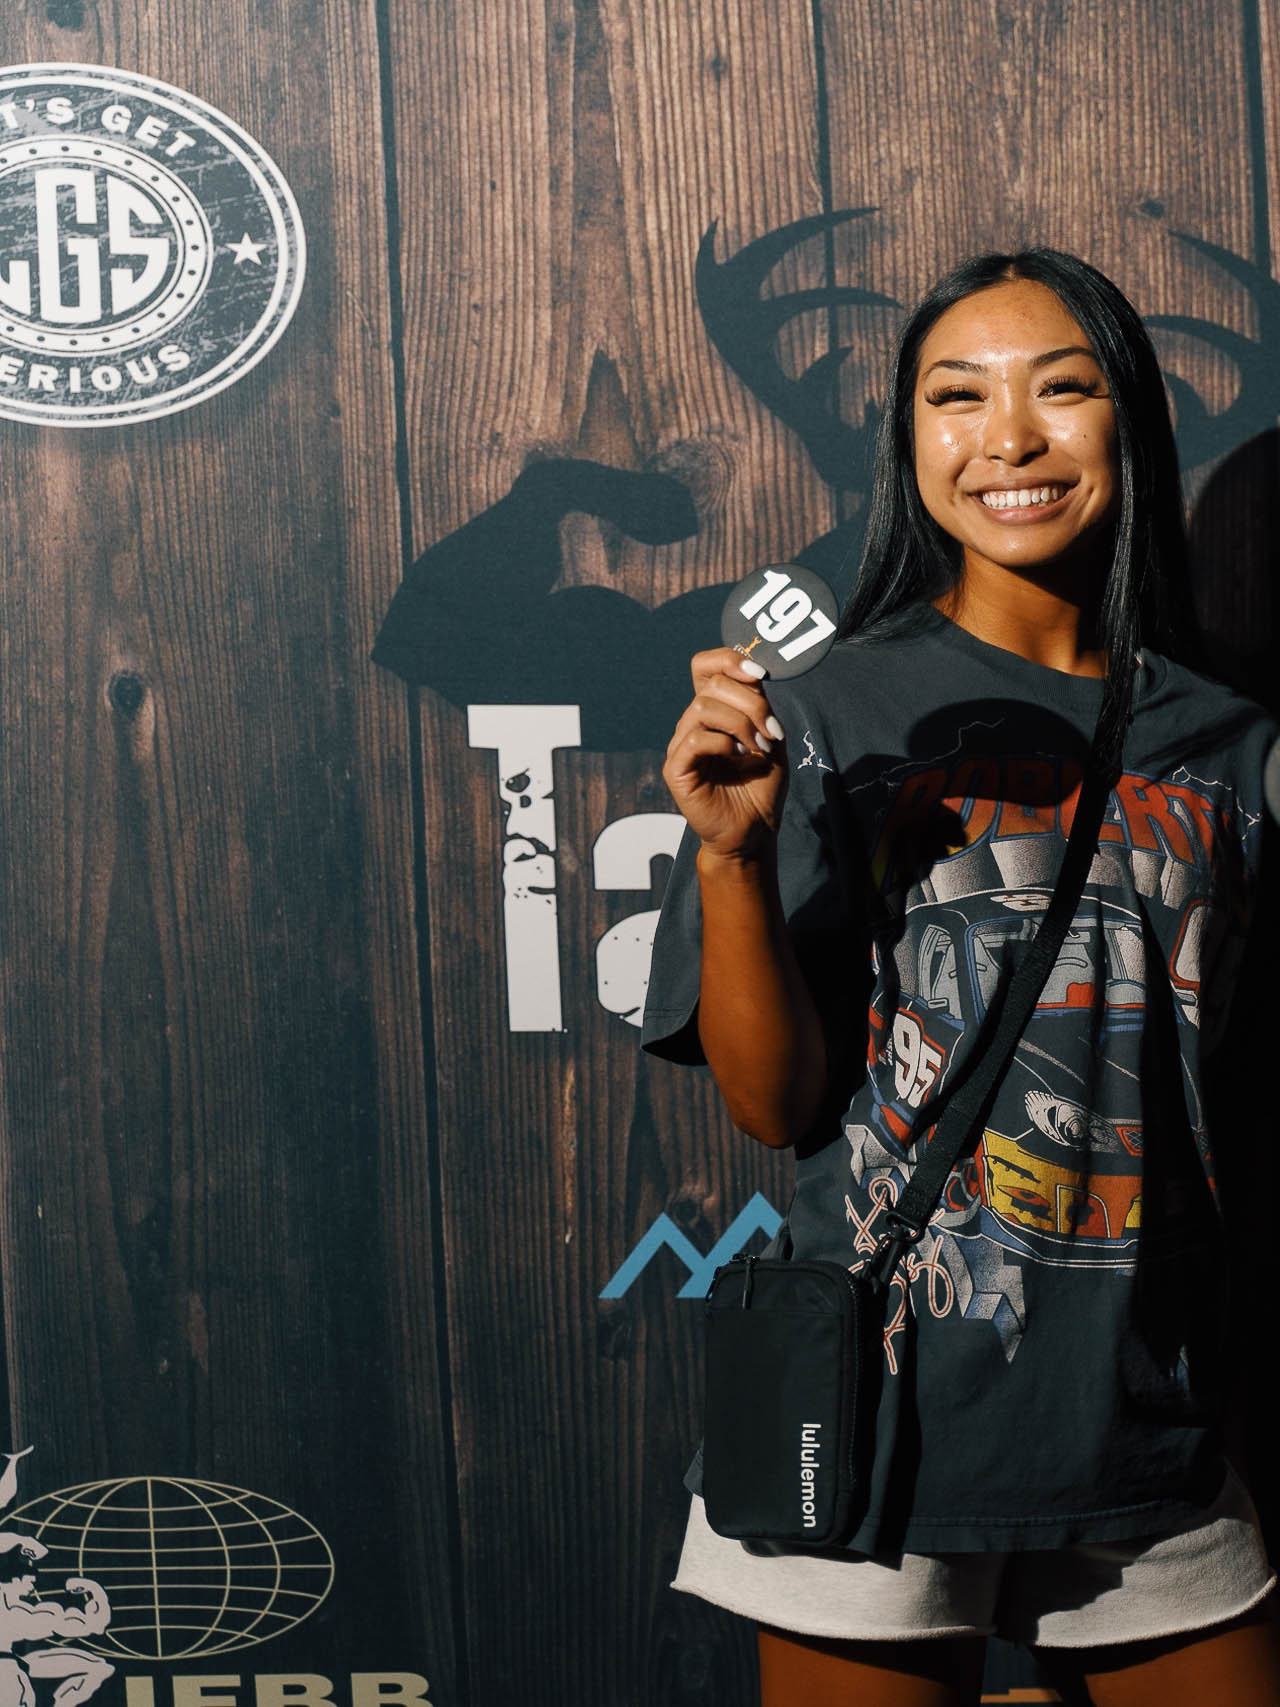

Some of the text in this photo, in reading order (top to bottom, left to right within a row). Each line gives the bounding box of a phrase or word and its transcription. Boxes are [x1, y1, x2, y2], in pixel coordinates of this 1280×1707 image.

[100, 104, 197, 158] GET
[0, 344, 191, 394] ERIOUS
[739, 569, 838, 662] 197
[892, 1011, 943, 1109] 95
[800, 1423, 822, 1528] lululemon
